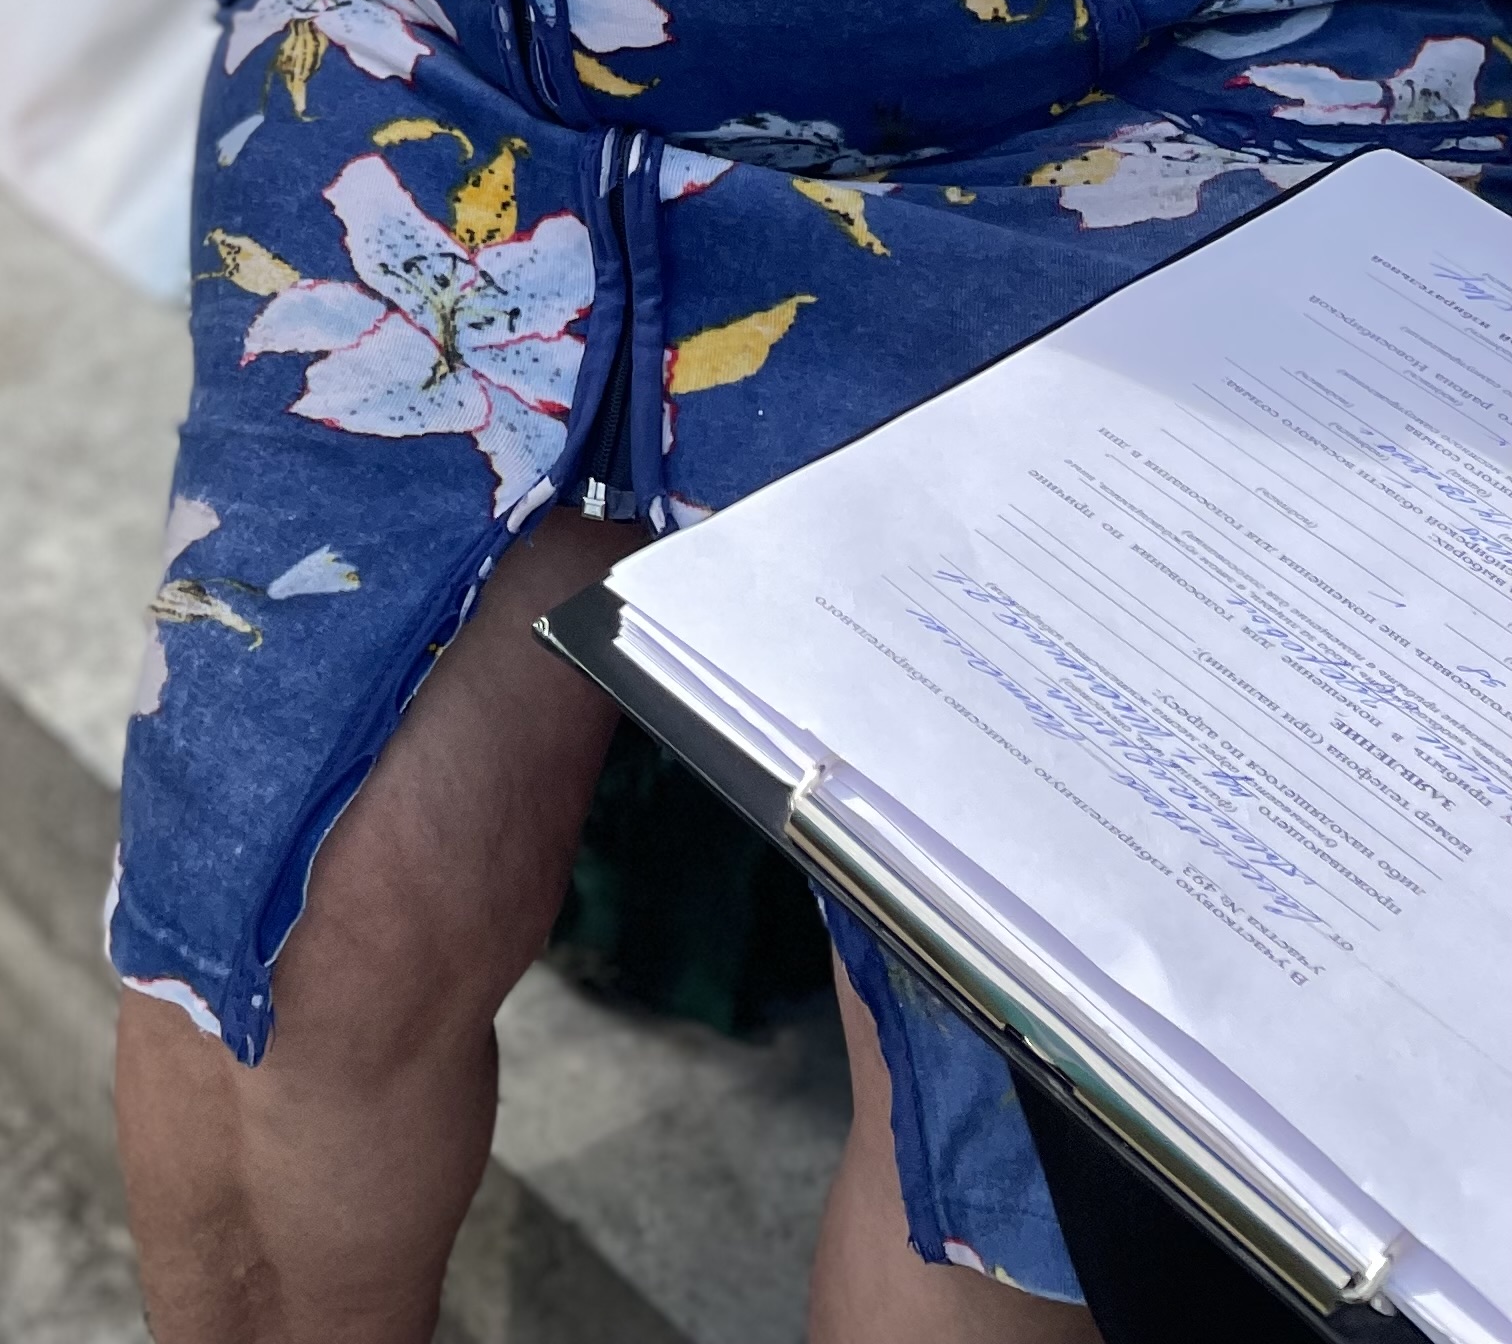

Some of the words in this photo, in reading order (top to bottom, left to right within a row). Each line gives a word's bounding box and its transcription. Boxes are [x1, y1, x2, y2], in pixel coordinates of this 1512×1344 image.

[1371, 256, 1490, 329] избирательной
[1309, 295, 1429, 372] Новосибирской
[1435, 373, 1494, 410] района
[1097, 427, 1131, 449] дни
[1282, 419, 1356, 470] восьмого
[1405, 424, 1461, 462] созыва
[1028, 470, 1095, 518] причине
[1143, 460, 1244, 531] голосования
[1356, 469, 1423, 514] области
[1102, 523, 1125, 540] по
[1243, 531, 1279, 553] для
[1129, 544, 1235, 622] голосования
[1428, 533, 1507, 586] выборах:
[1278, 554, 1377, 624] помещения
[815, 596, 943, 695] избирательного
[1240, 625, 1276, 650] для
[1379, 624, 1411, 648] вне
[1192, 648, 1280, 711] наличии):
[1281, 655, 1383, 728] помещение
[944, 696, 1032, 765] комиссию
[1152, 689, 1219, 739] адресу:
[1152, 707, 1200, 741] места
[1281, 712, 1324, 744] (при
[1199, 743, 1240, 777] адрес
[1221, 740, 1245, 760] по
[1330, 718, 1456, 811] ЗАЯВЛЕНИЕ
[1327, 744, 1410, 810] телефона
[1414, 746, 1493, 808] прибыть
[1034, 767, 1174, 876] избирательную
[1246, 760, 1375, 859] находящегося
[1414, 810, 1472, 855] номер
[1183, 867, 1218, 892] 493
[1258, 806, 1402, 915] проживающего
[1378, 860, 1426, 896] либо
[1176, 877, 1291, 970] участковую
[1220, 893, 1245, 915] №
[1247, 913, 1326, 975] участка
[1329, 934, 1354, 951] от
[1290, 970, 1309, 986] В
